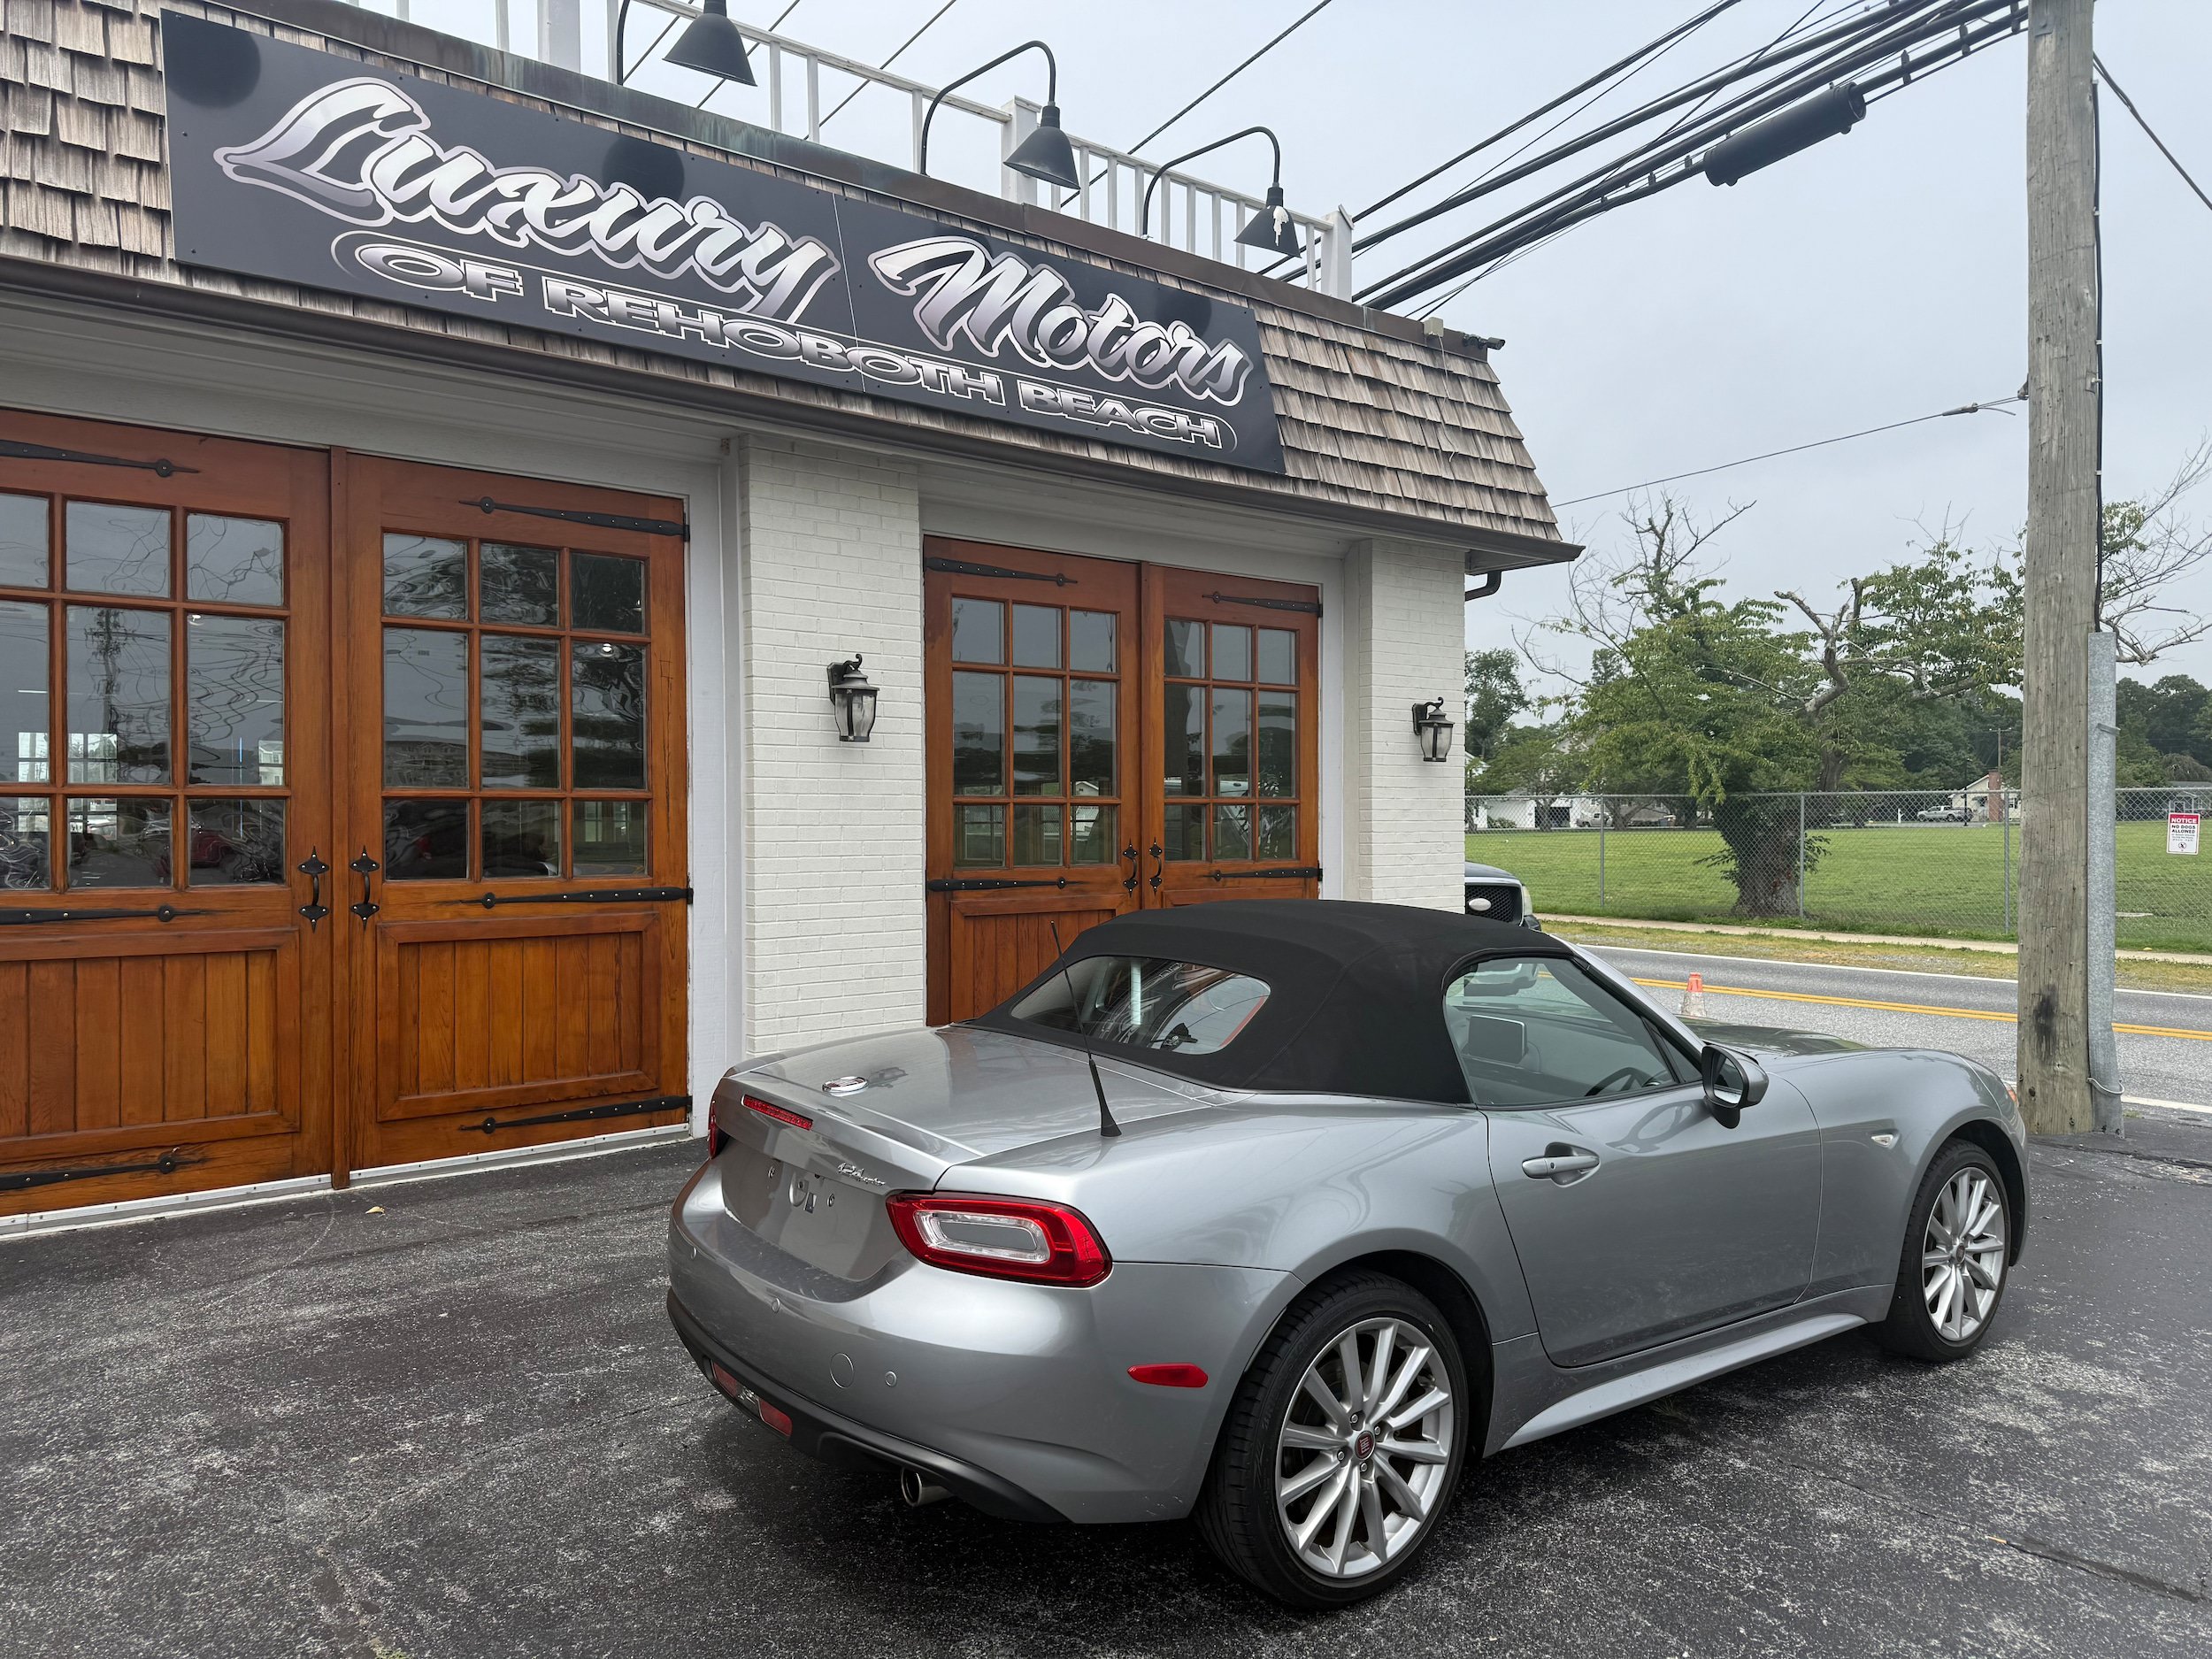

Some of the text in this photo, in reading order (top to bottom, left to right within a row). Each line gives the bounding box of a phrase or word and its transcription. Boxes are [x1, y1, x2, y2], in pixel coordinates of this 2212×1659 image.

[213, 77, 1254, 406] Luxury Motors
[355, 243, 1223, 449] OF REHOBOTH BEACH
